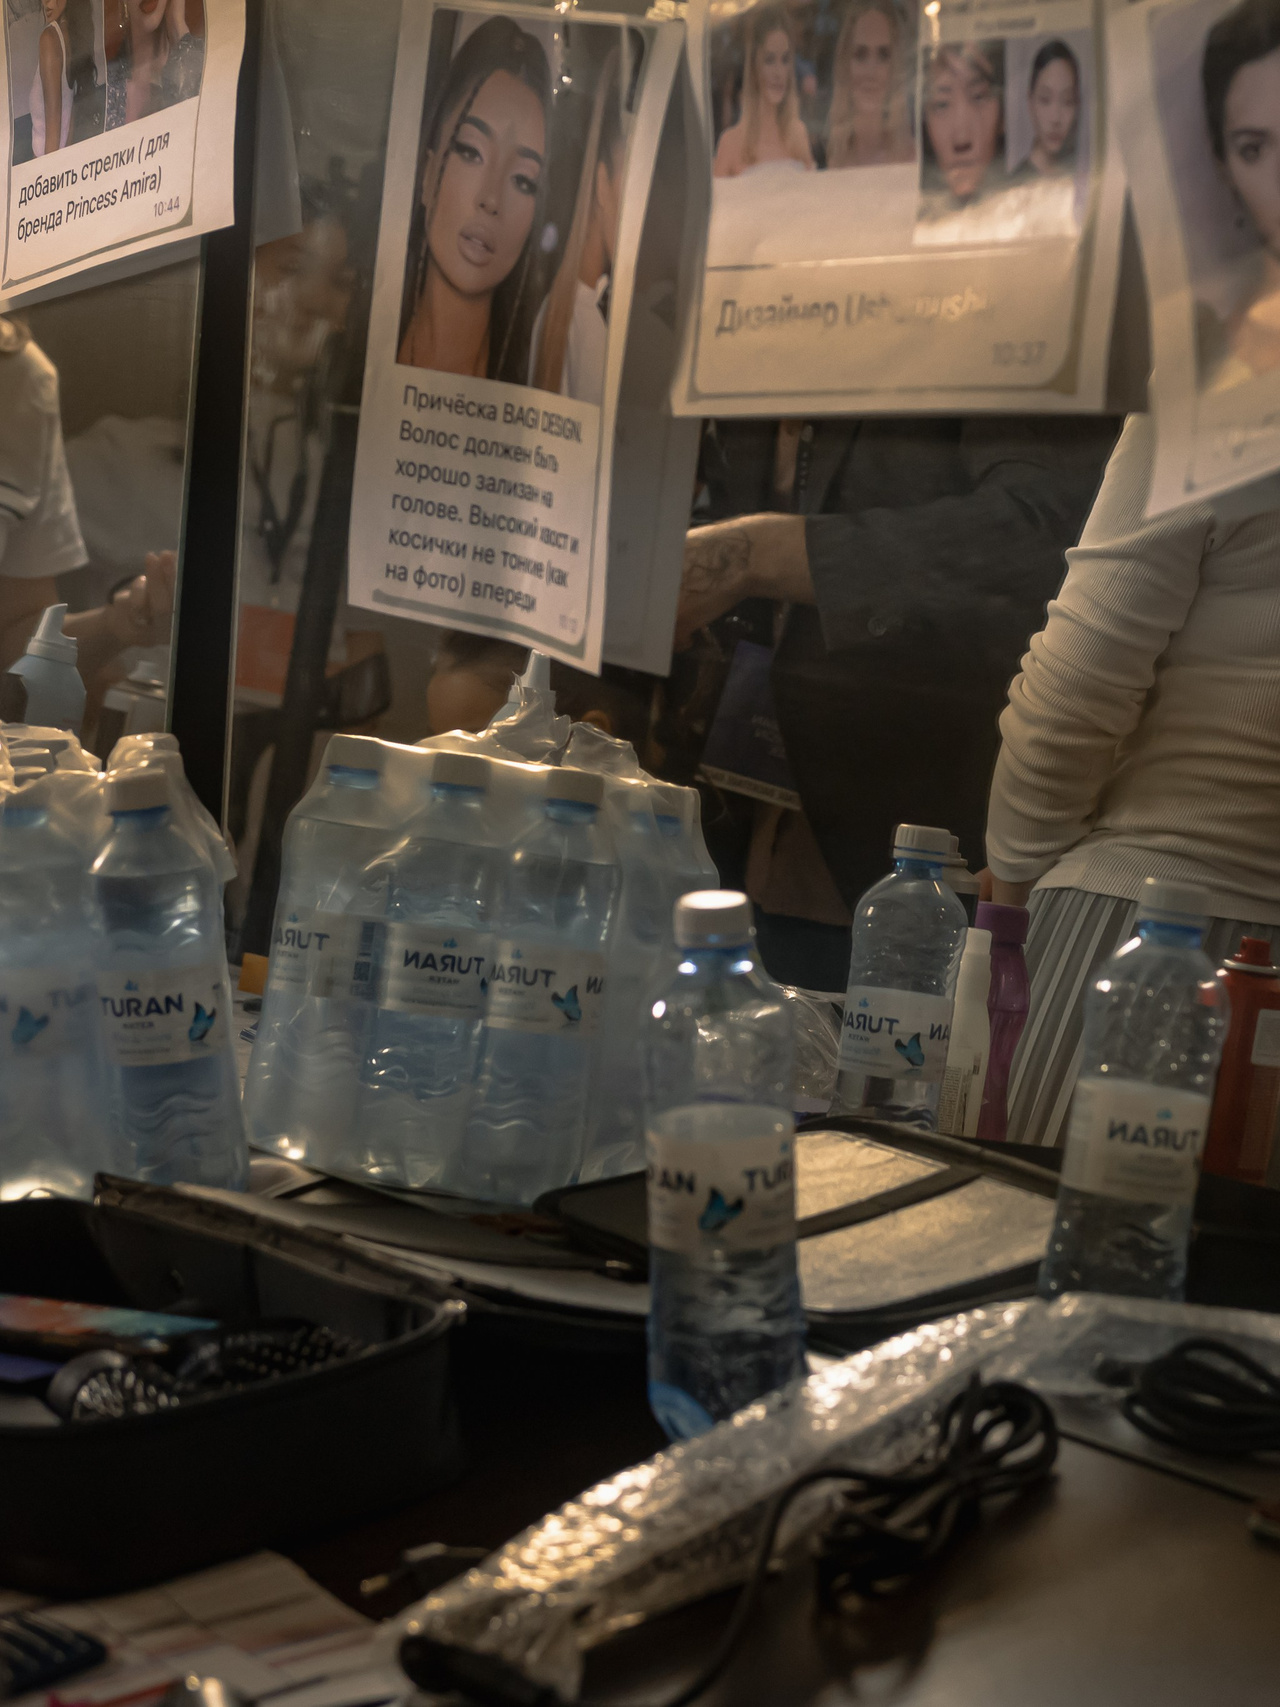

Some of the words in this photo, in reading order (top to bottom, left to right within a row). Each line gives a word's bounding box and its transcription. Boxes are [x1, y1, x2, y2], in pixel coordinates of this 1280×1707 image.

[18, 169, 78, 208] добавить
[81, 146, 136, 181] стрелки
[145, 132, 170, 160] для
[17, 209, 62, 243] бренда
[65, 188, 118, 223] Princess
[120, 165, 162, 202] Amira)
[154, 196, 181, 218] 10:44
[402, 385, 498, 421] Причёска
[399, 420, 460, 450] Волос
[463, 436, 533, 465] должен
[395, 458, 471, 488] хорошо
[391, 494, 463, 522] голове.
[468, 504, 538, 539] Высокий
[388, 528, 467, 559] косички
[471, 546, 495, 565] не
[501, 550, 544, 580] тонкие
[385, 563, 408, 582] на
[413, 565, 466, 599] фото)
[471, 581, 537, 612] впереди
[101, 992, 184, 1018] TURAN
